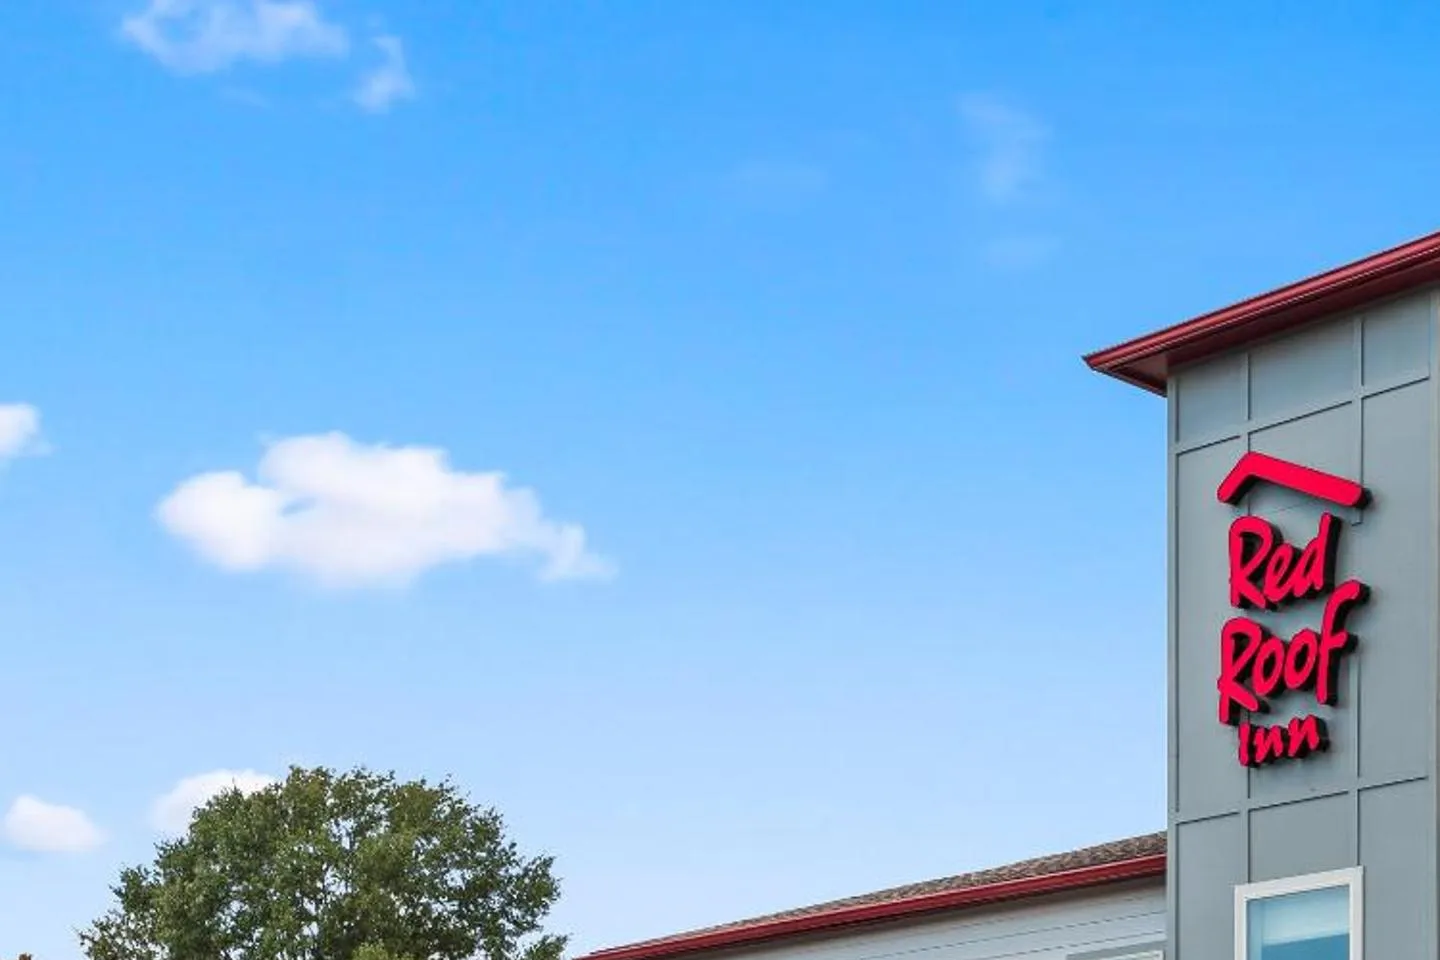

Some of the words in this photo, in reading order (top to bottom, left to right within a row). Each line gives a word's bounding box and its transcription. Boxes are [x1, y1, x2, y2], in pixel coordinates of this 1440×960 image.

[1228, 511, 1332, 609] Red
[1217, 579, 1362, 725] Roof
[1238, 714, 1321, 767] Inn
